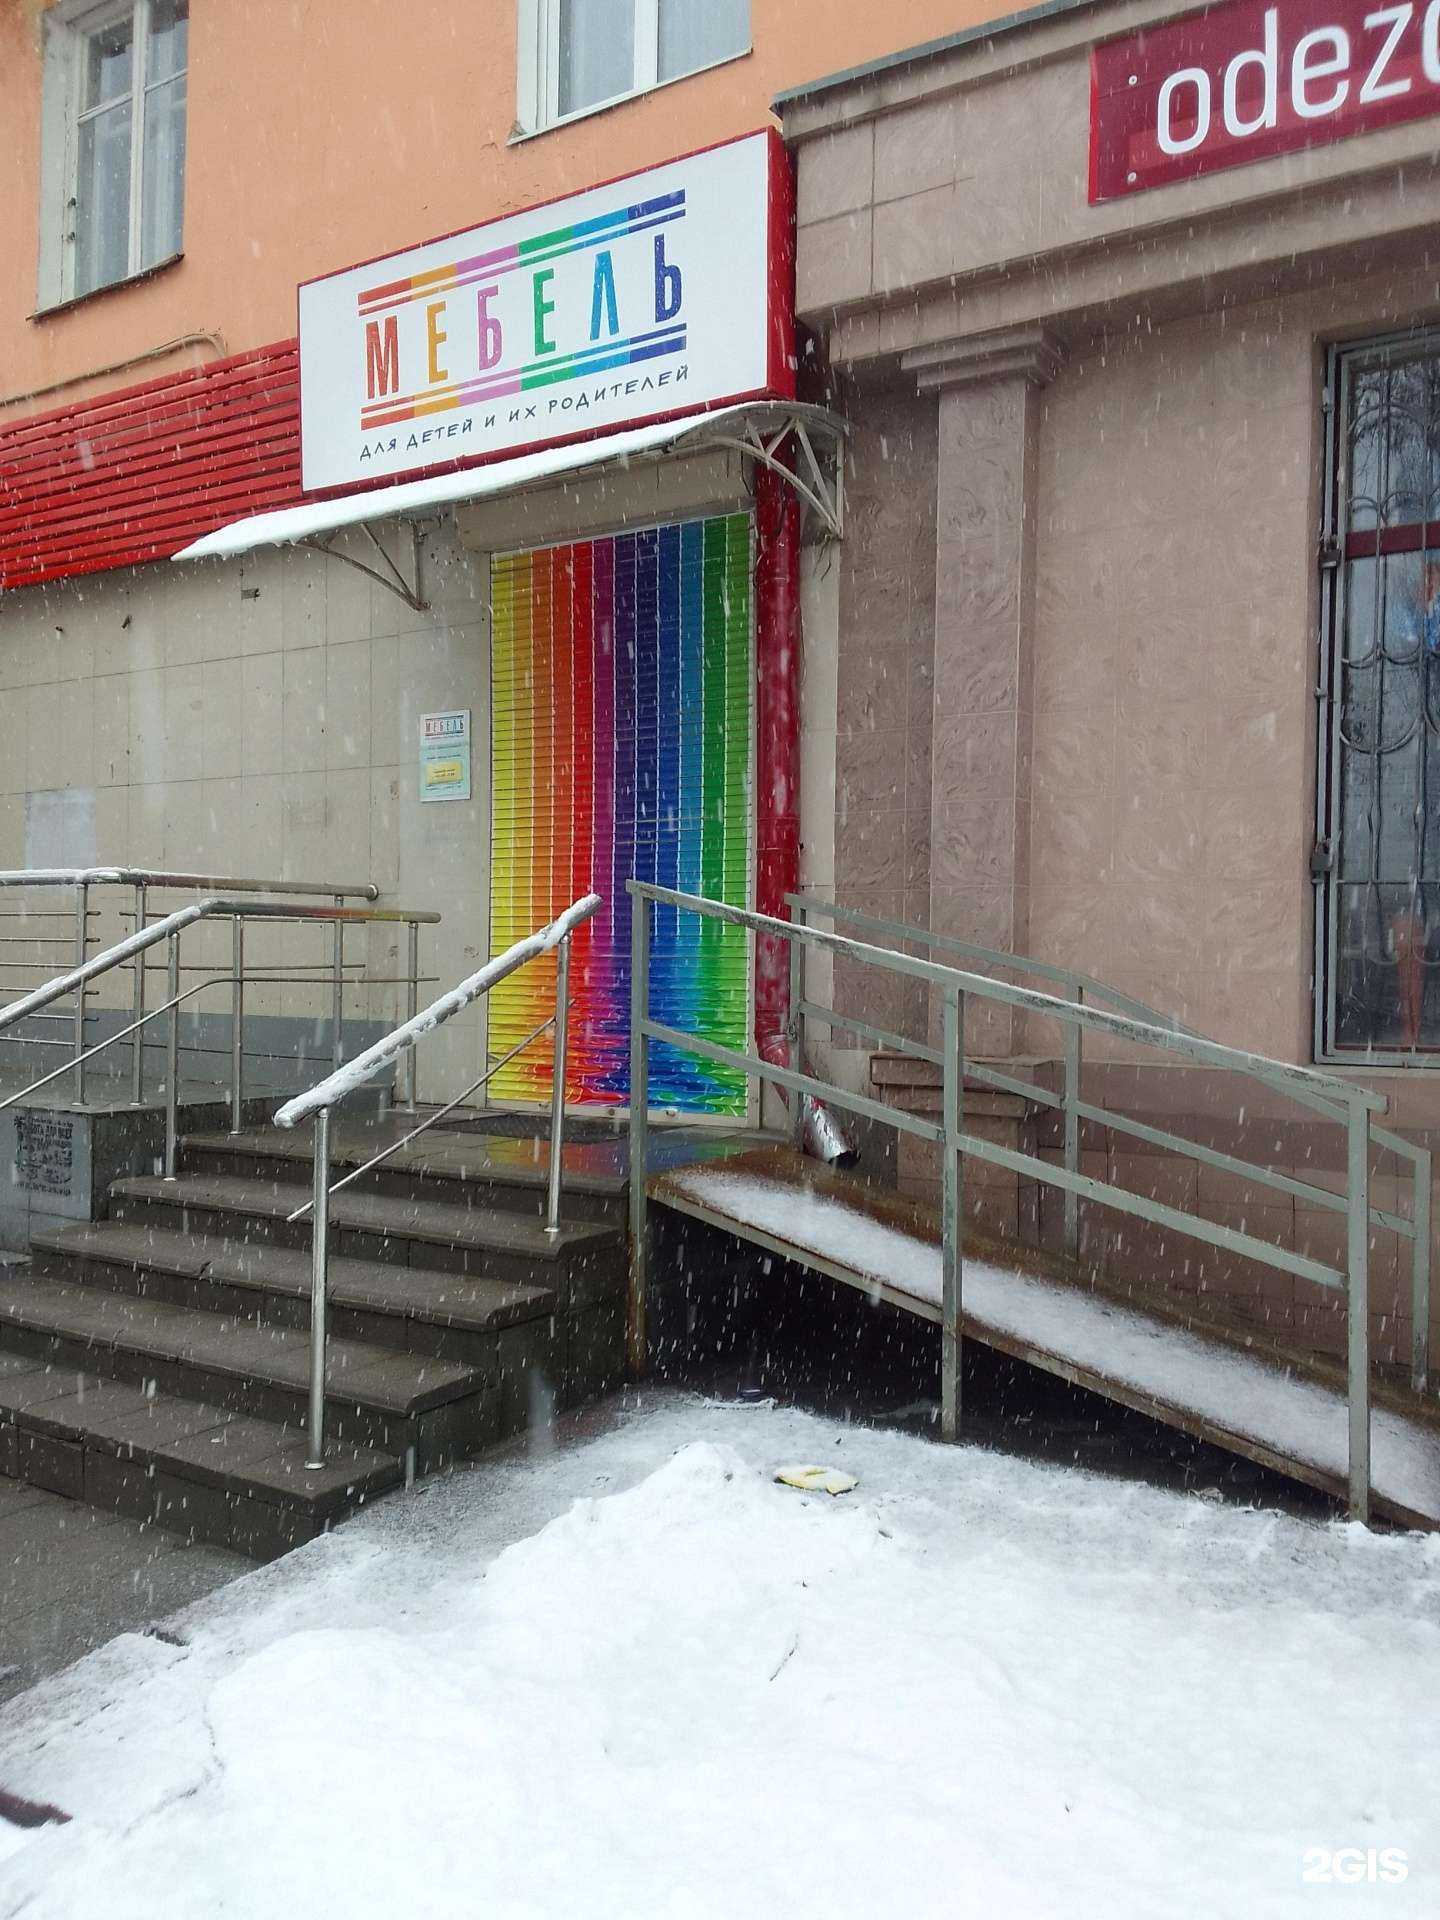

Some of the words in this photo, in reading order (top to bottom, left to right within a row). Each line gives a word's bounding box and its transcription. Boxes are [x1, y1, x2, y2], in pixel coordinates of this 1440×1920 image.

[365, 233, 682, 400] МЕБЕЛЬ
[359, 438, 396, 461] ДЛЯ
[406, 418, 473, 450] ДЕТЕЙ
[484, 415, 496, 427] И
[508, 405, 537, 423] ИХ
[548, 363, 689, 414] РОДИТЕЛЕЙ
[425, 719, 464, 733] МЕБЕЛЬ
